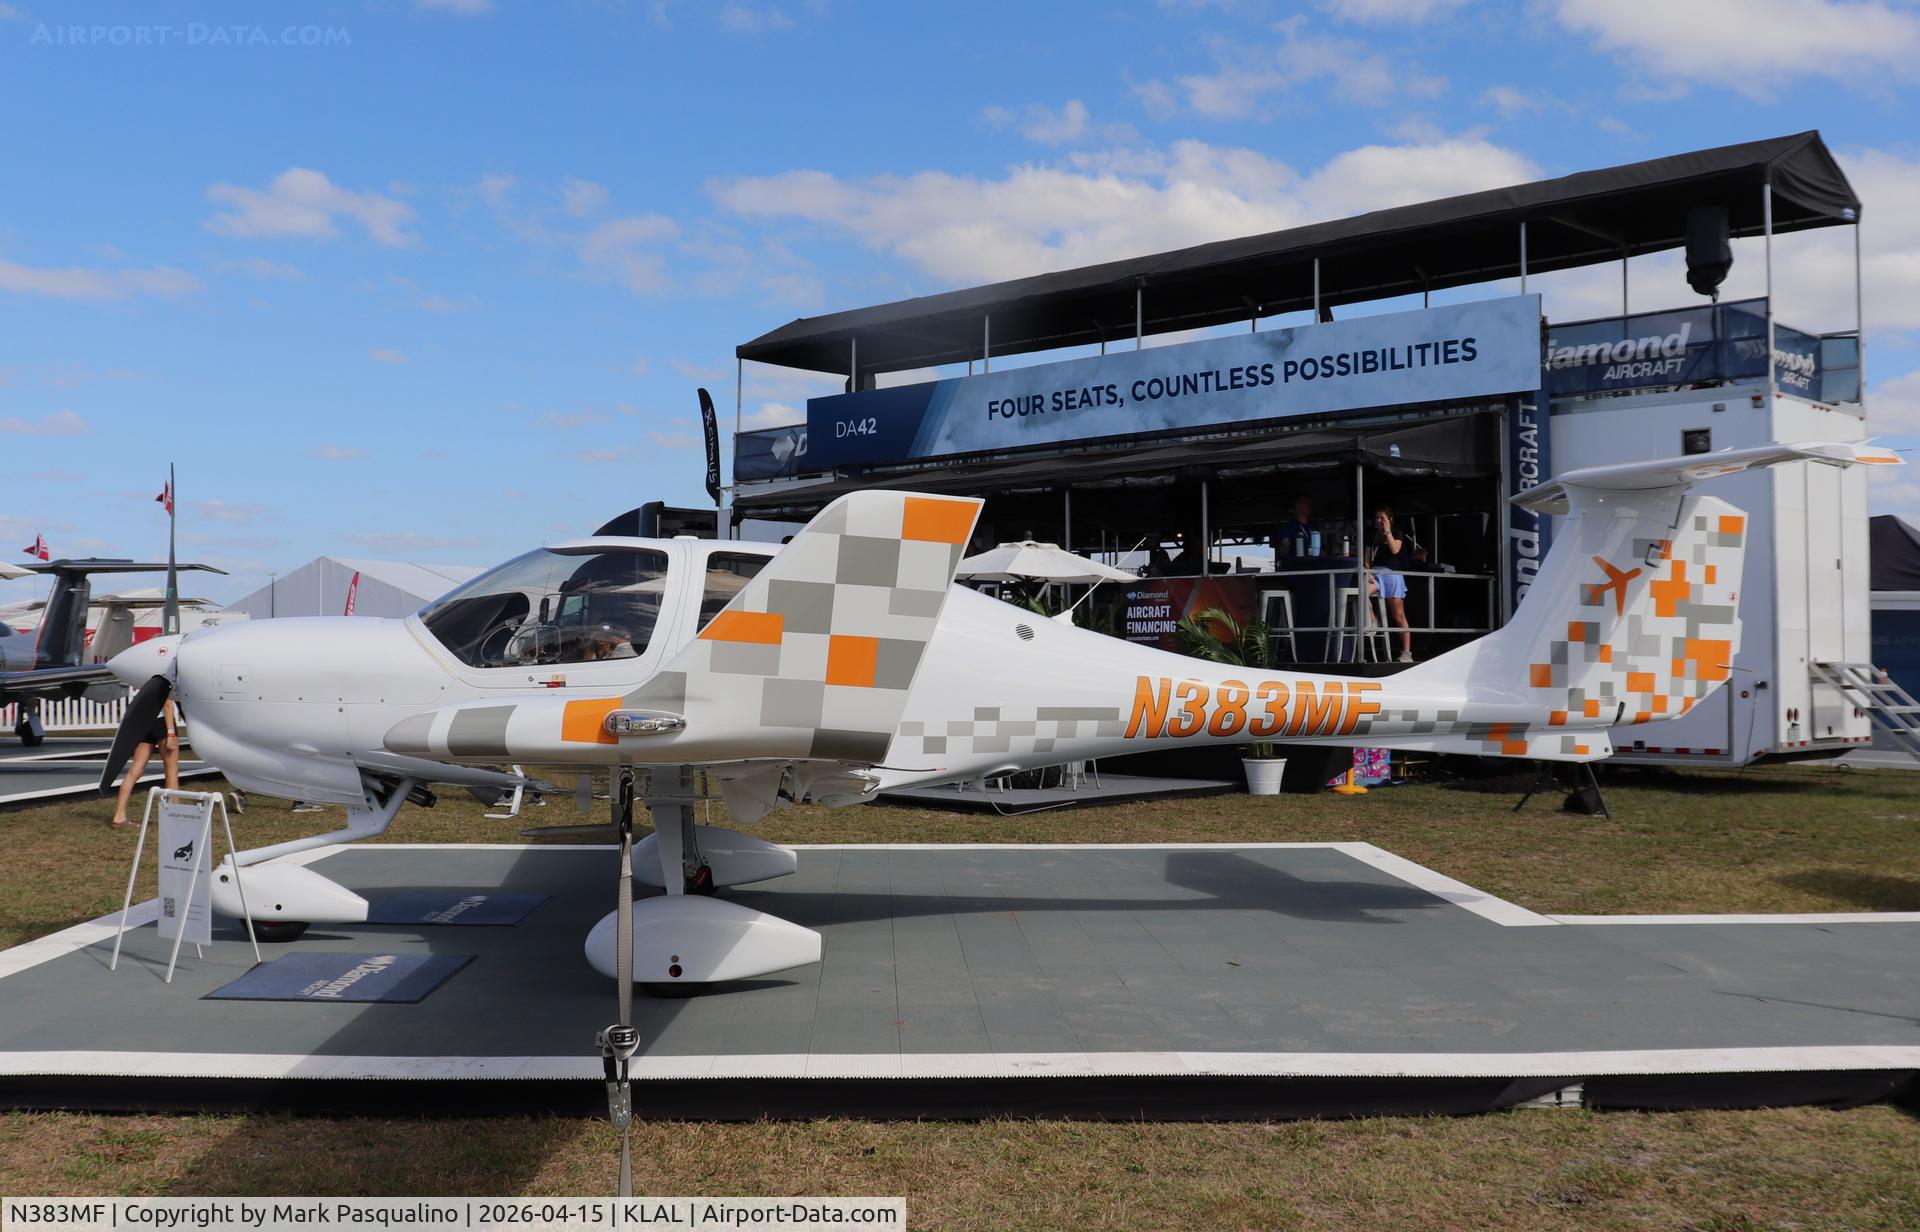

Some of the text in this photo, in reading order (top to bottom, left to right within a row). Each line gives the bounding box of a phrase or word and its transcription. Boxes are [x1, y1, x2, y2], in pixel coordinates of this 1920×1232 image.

[1545, 322, 1692, 370] iamond
[988, 337, 1478, 420] FOUR SEATS, COUNTLESS POSSIBILITIES
[1603, 358, 1686, 380] AIRCRAFT
[835, 417, 877, 438] DA42
[1519, 398, 1539, 518] RCRAFT
[1137, 590, 1169, 600] Diamond
[1126, 605, 1171, 619] AIRCRAFT
[1126, 620, 1177, 634] FINANCING
[1123, 675, 1383, 739] N383MF
